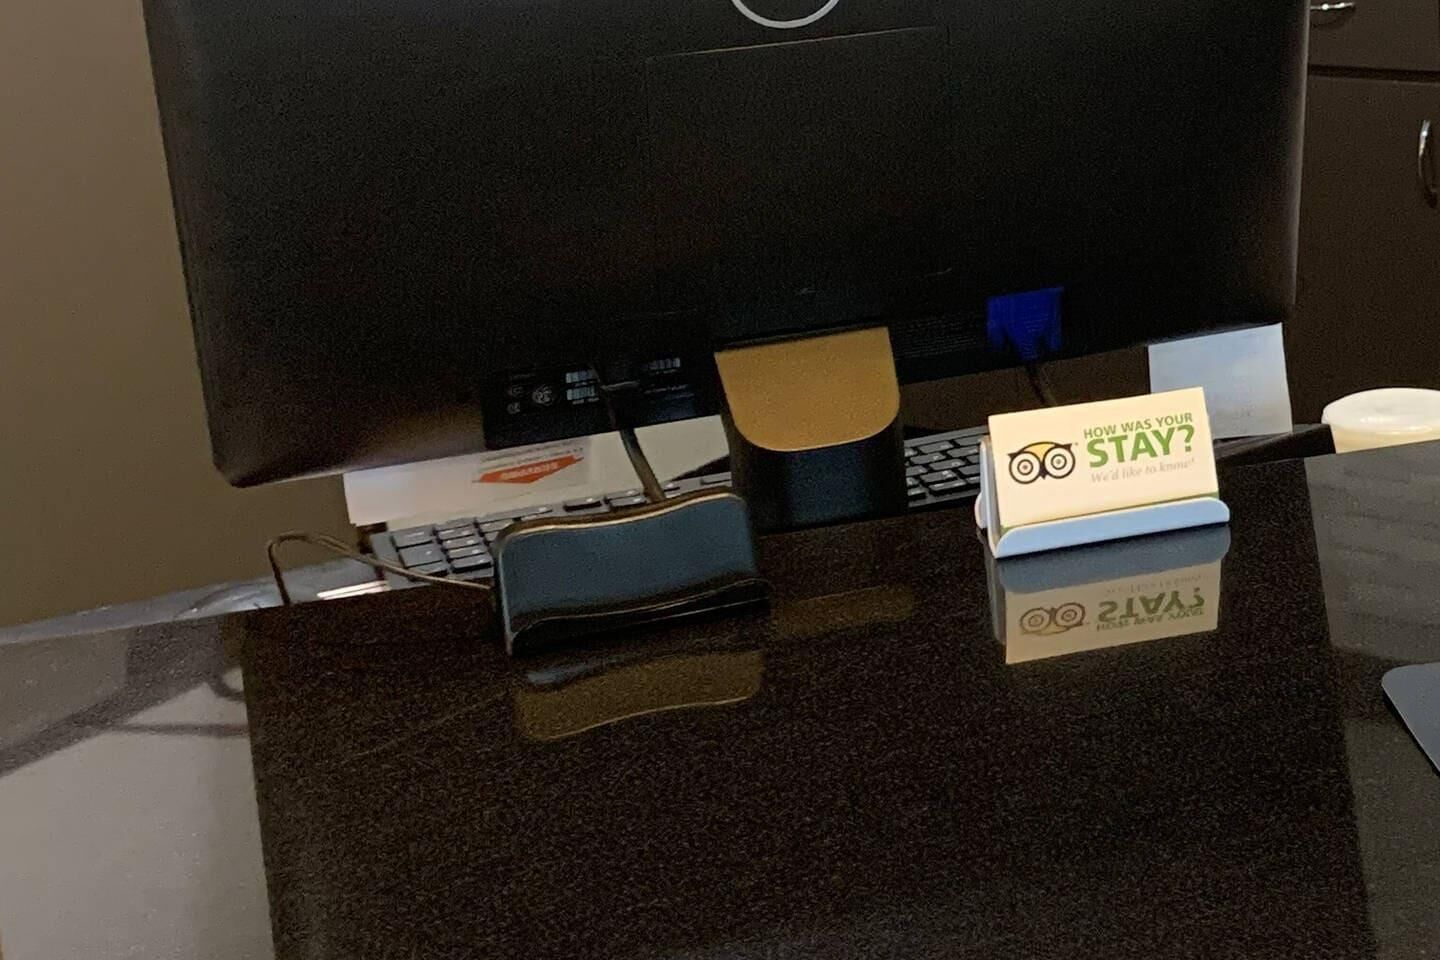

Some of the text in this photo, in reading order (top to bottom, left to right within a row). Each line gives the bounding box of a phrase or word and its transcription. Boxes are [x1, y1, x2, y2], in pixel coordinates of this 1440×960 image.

[1083, 412, 1193, 439] HOW WAS YOUR
[1086, 423, 1195, 468] STAY?
[1145, 465, 1157, 475] to
